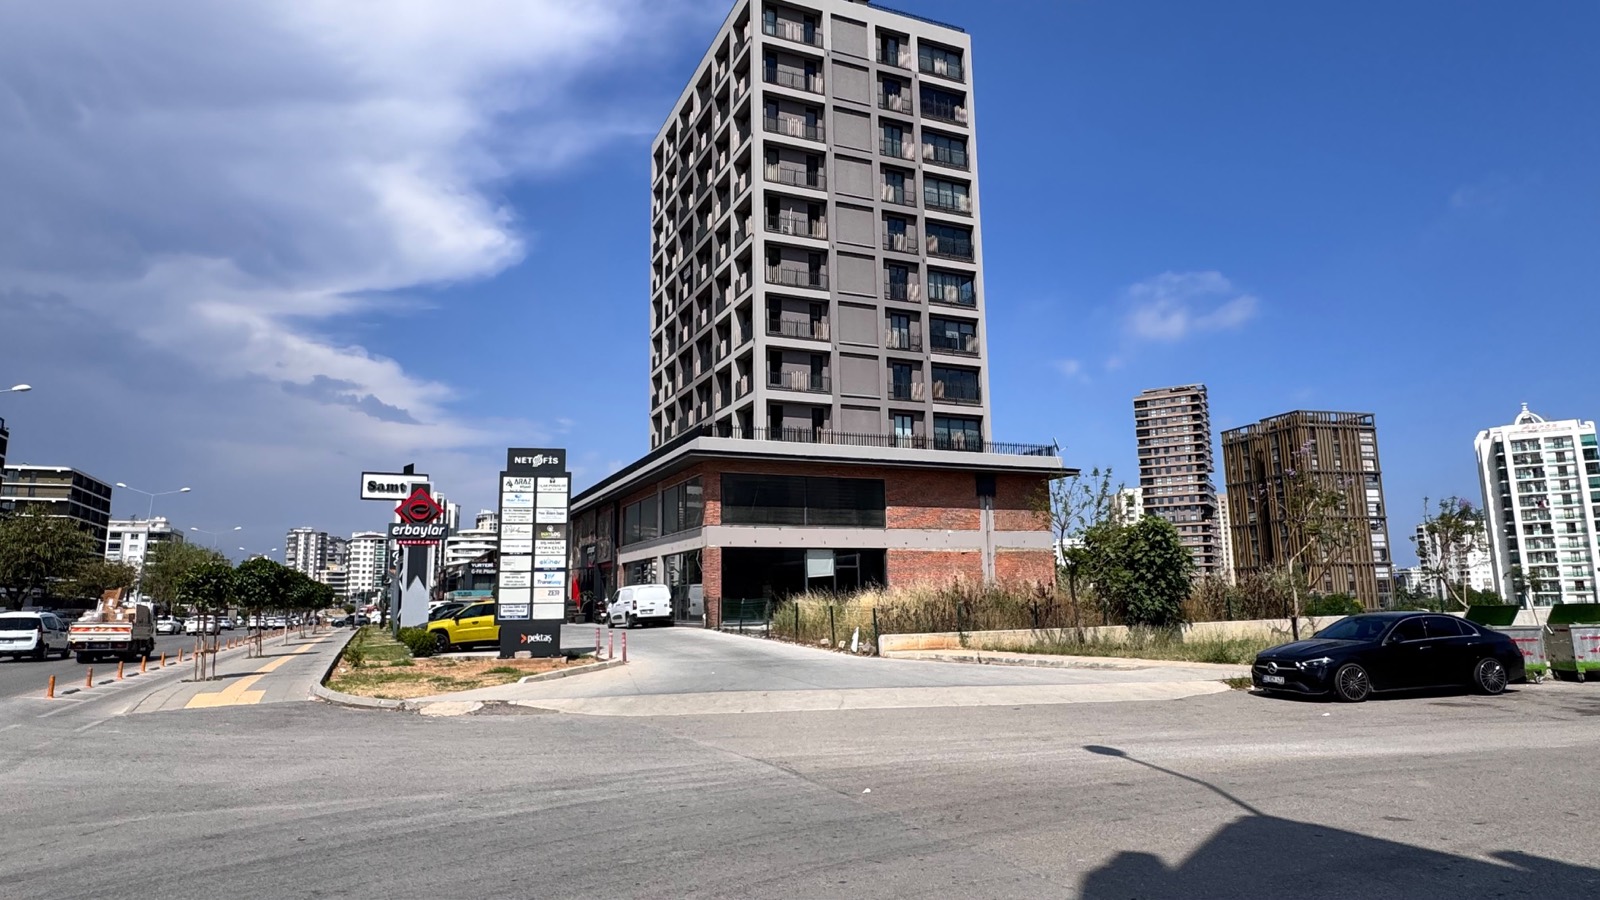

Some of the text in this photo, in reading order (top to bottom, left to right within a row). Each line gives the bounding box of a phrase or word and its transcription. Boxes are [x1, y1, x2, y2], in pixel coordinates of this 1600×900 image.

[367, 480, 407, 494] Samt
[392, 524, 445, 538] erbaylar
[527, 633, 552, 643] pektaş
